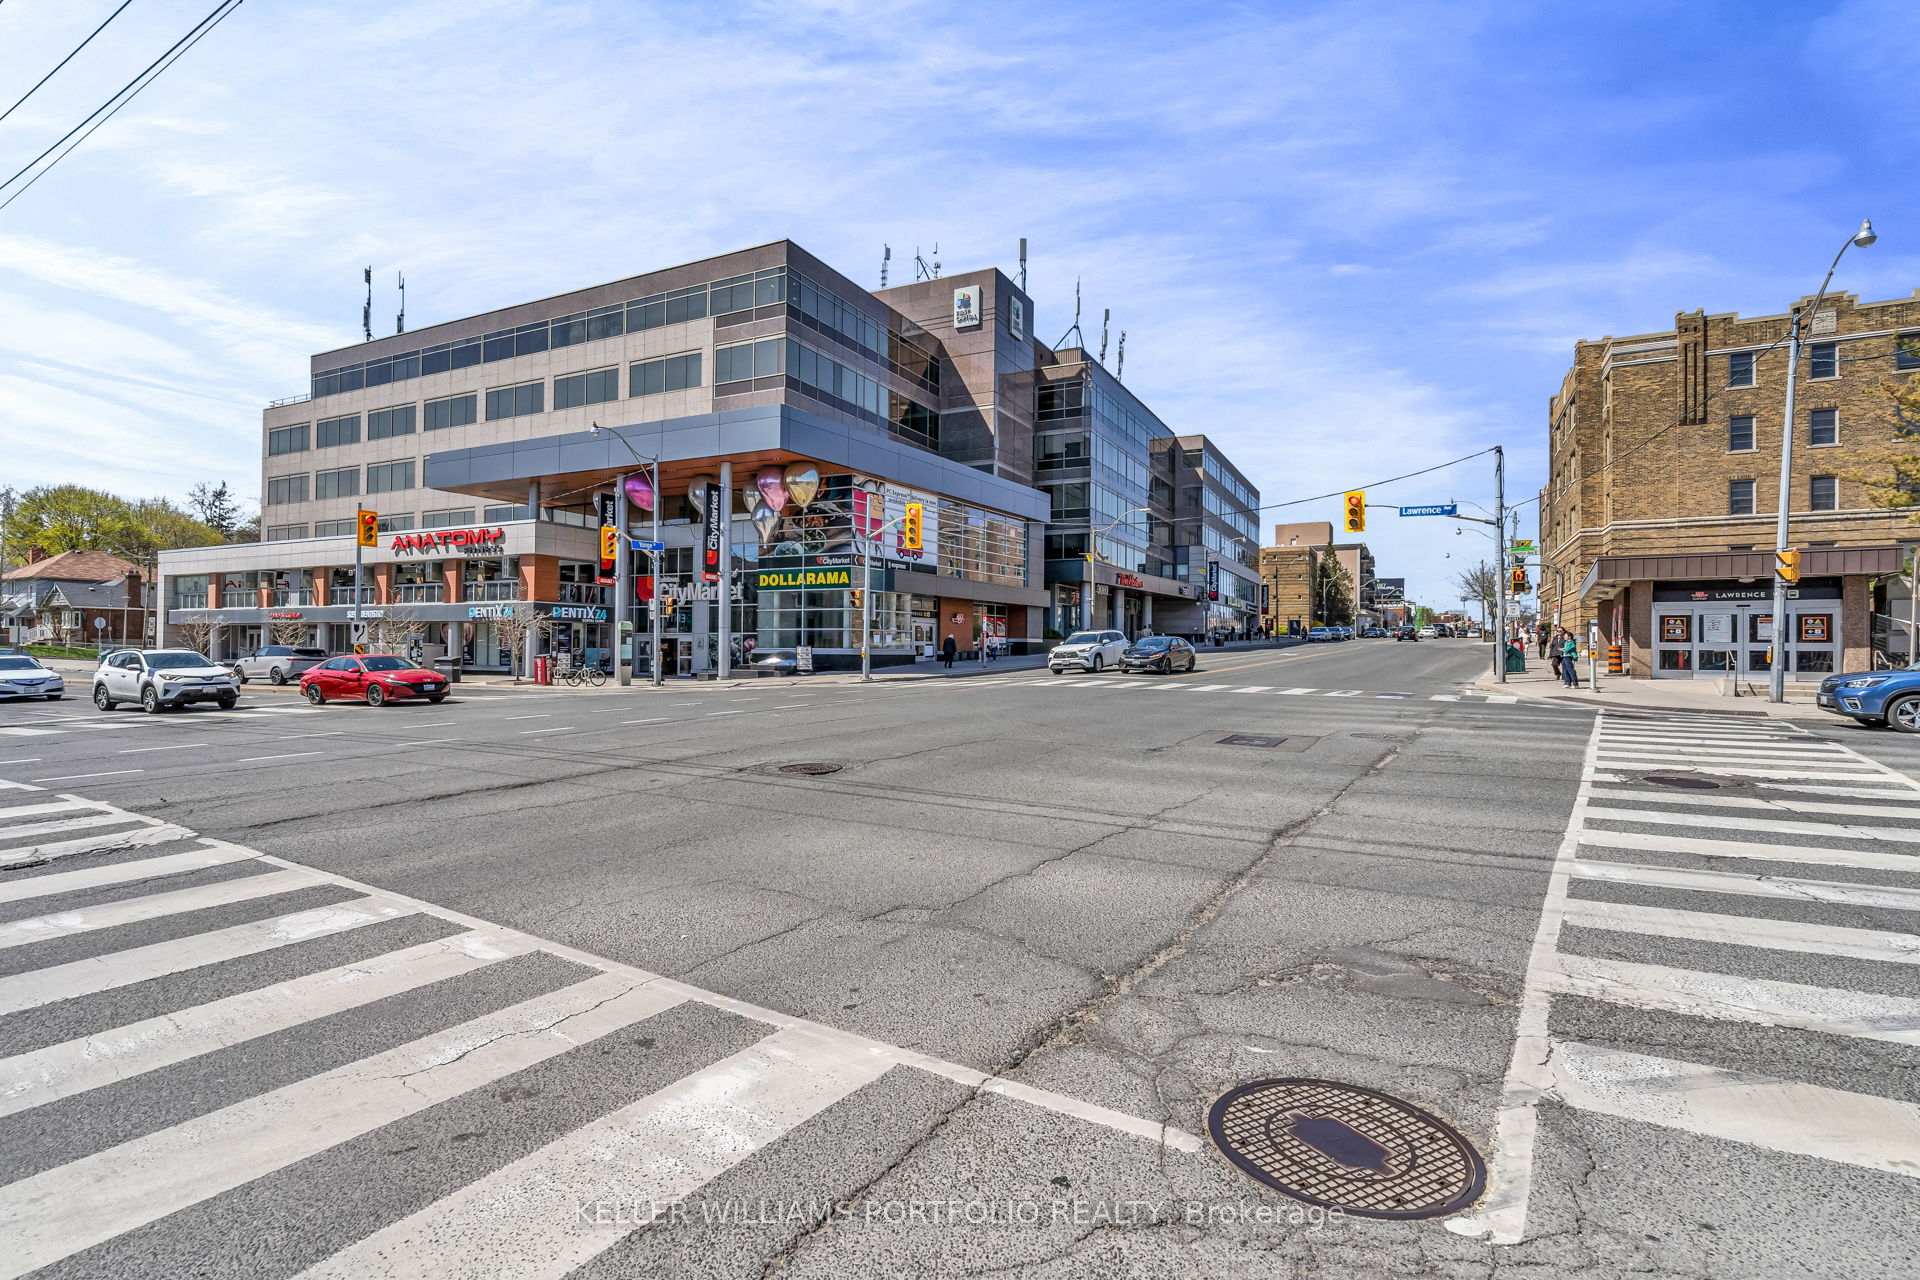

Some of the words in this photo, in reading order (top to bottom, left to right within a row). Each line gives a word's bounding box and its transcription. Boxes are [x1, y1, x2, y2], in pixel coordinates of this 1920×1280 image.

[1402, 506, 1442, 515] Lawrence
[391, 528, 506, 550] ANATOMY
[759, 571, 850, 587] DOLLARAMA
[1715, 591, 1767, 599] LAWRENCE
